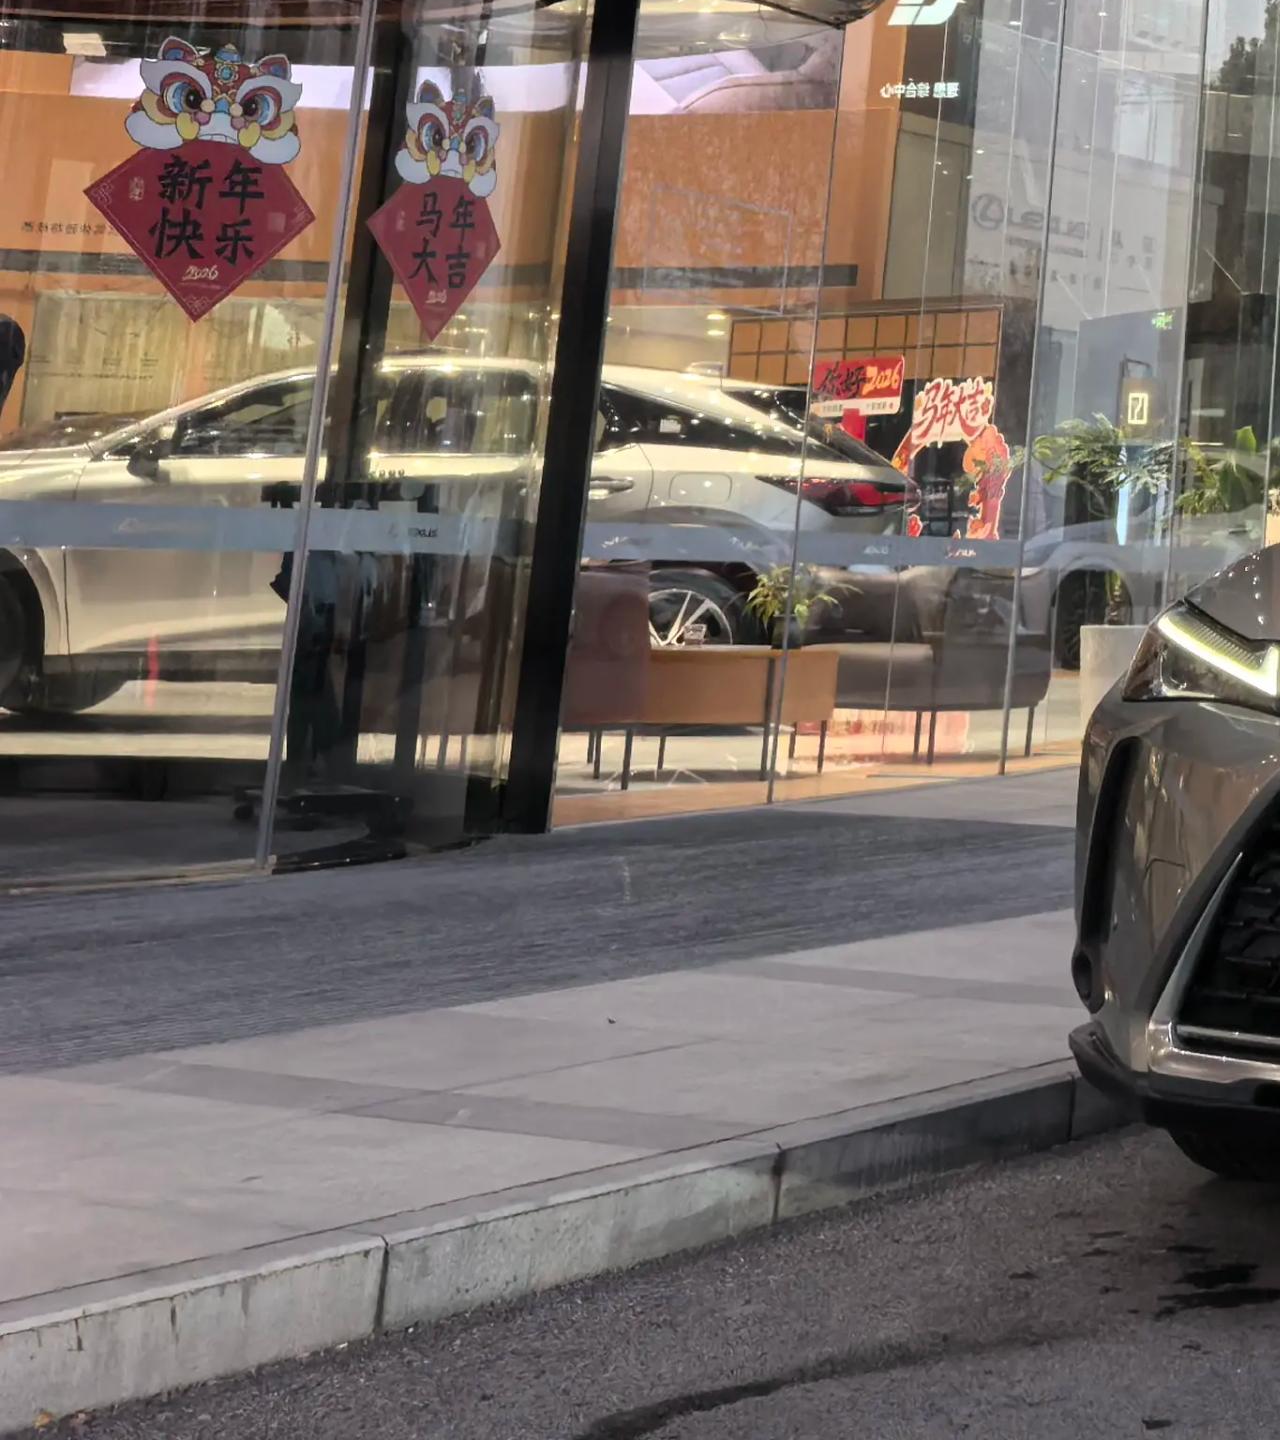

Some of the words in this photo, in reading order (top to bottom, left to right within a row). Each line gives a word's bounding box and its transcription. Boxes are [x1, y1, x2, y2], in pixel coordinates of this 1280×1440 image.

[158, 155, 265, 214] 新年
[149, 208, 255, 265] 快乐
[416, 192, 475, 244] 马年
[182, 265, 219, 281] 2026
[408, 237, 471, 288] 大吉
[912, 380, 985, 438] 马年大吉
